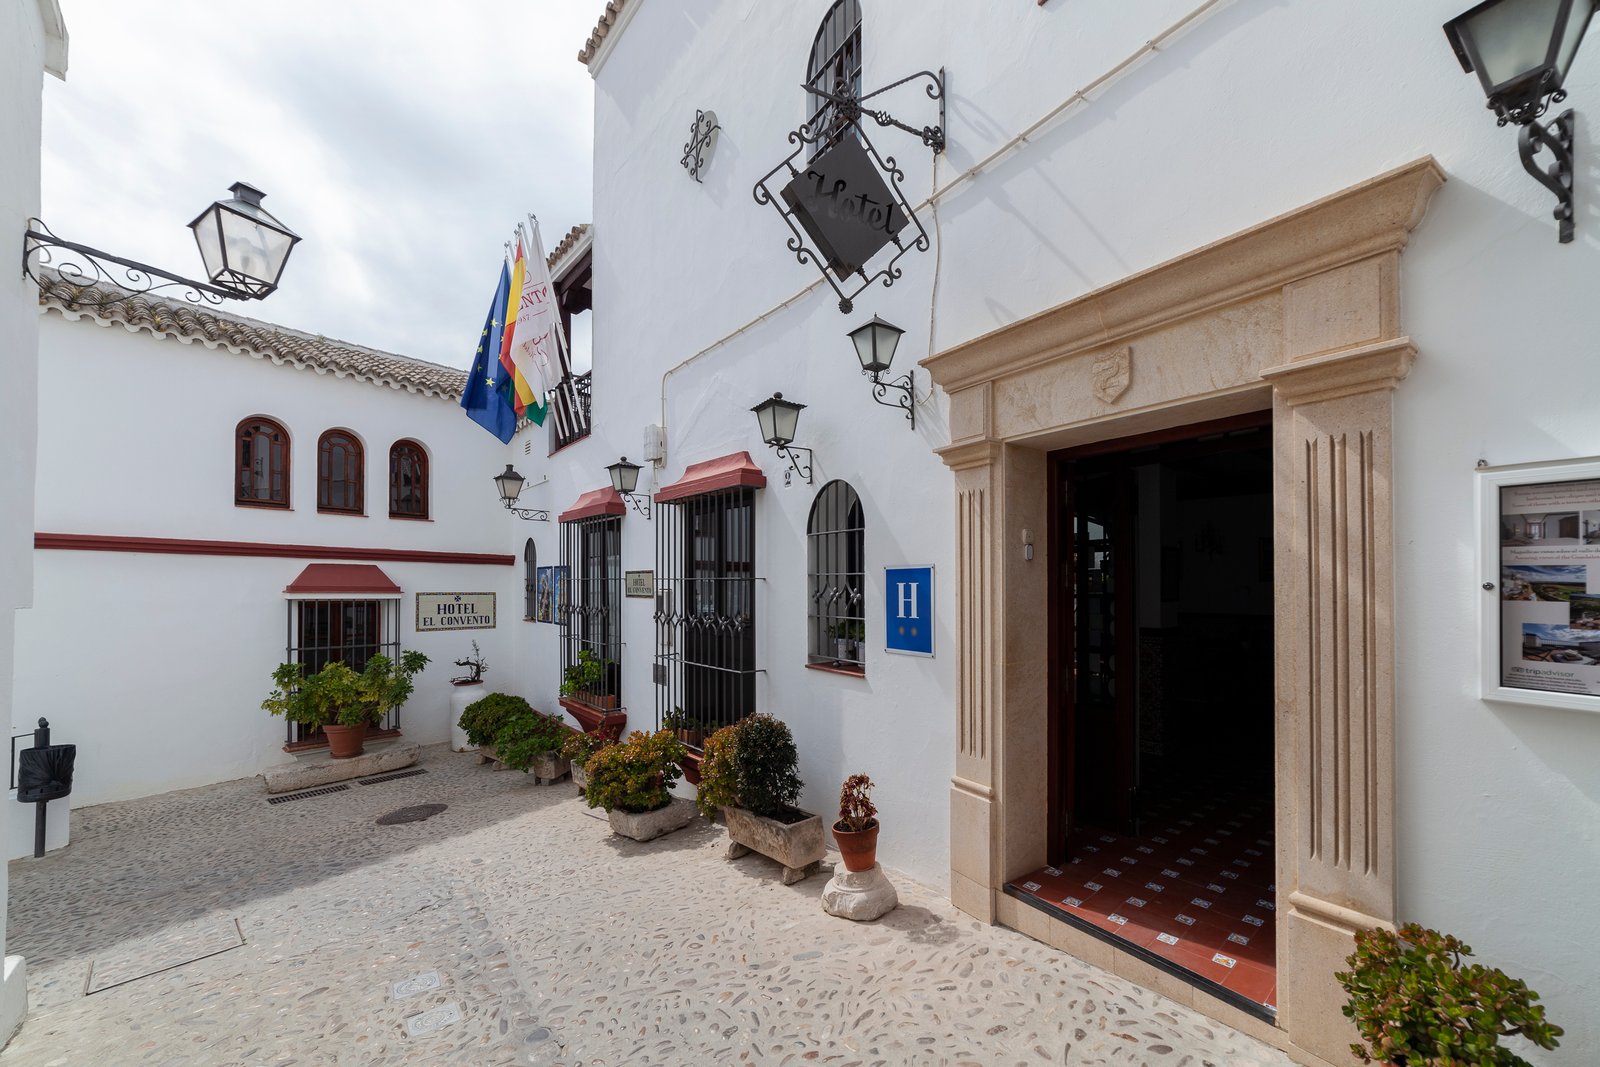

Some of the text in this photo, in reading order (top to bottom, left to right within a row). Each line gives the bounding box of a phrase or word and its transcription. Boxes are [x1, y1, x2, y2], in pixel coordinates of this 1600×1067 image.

[807, 170, 895, 235] Hotel
[896, 582, 920, 619] H
[437, 603, 478, 615] HOTEL
[423, 615, 490, 627] EL CONVENTO
[1525, 667, 1575, 678] tripadvisor
